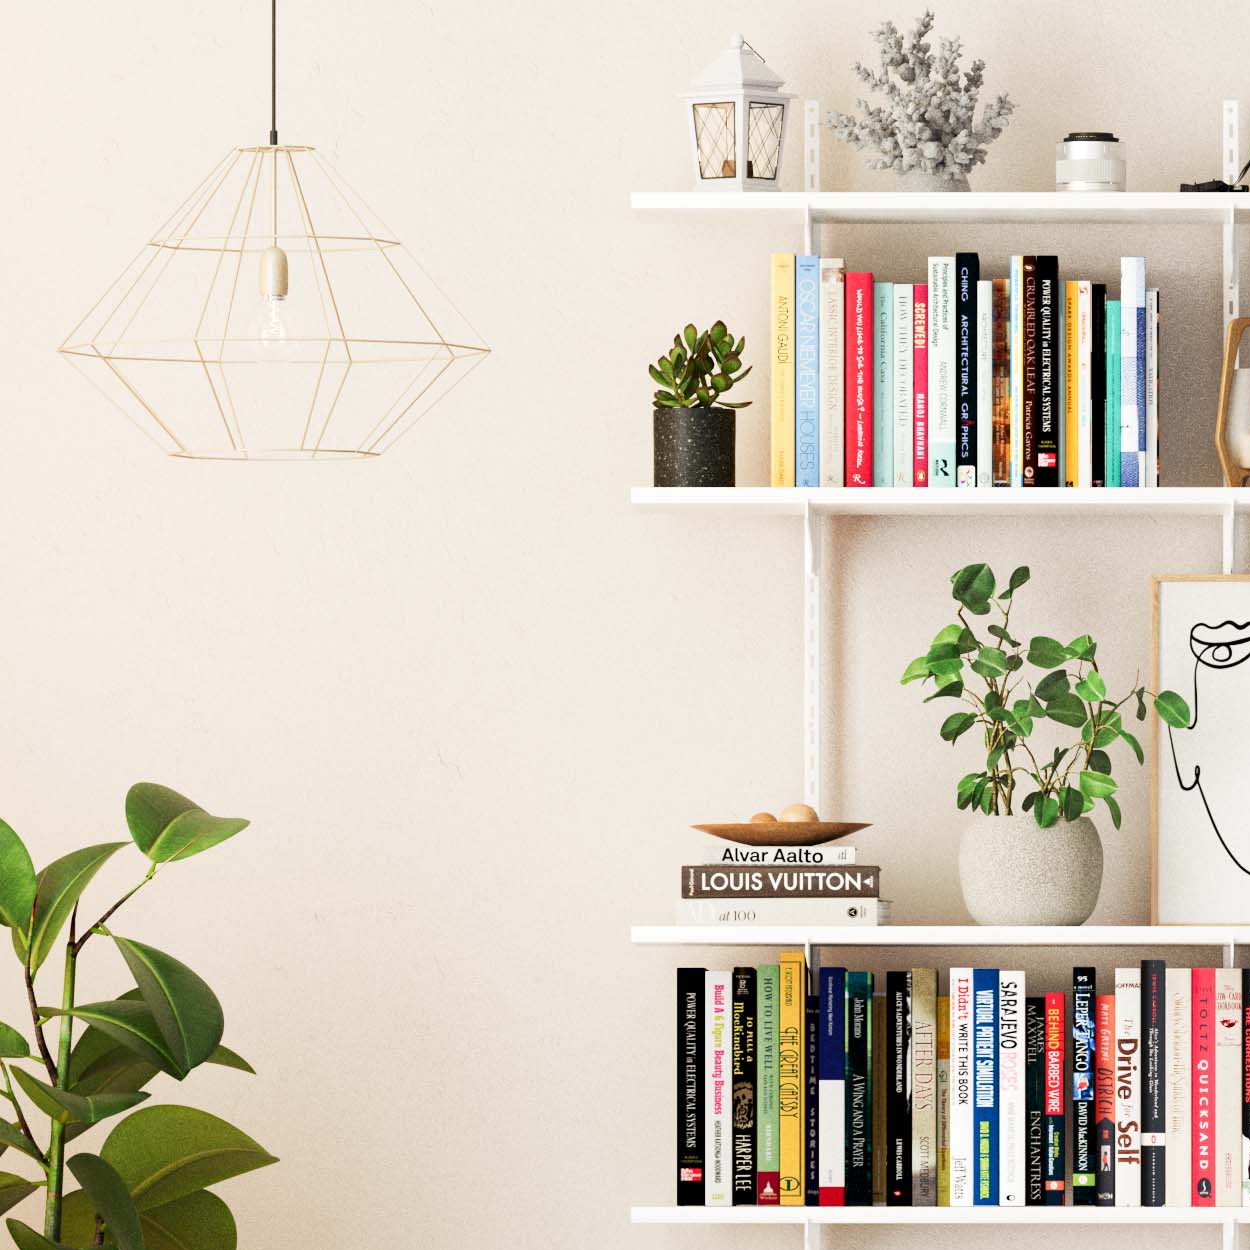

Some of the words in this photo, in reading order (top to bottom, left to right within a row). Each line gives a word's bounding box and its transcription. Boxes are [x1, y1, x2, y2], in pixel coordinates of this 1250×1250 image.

[961, 267, 969, 302] CHING
[1041, 280, 1050, 305] POWER
[801, 279, 815, 333] OSCAR
[1026, 277, 1036, 336] CRUMBLED
[915, 302, 925, 349] SCREWED!
[1041, 307, 1050, 340] QUALITY
[961, 315, 969, 396] ARCHITECTURAL
[1026, 339, 1036, 364] OAK
[801, 335, 816, 409] NIEMEYER
[1026, 367, 1036, 394] LEAF
[1041, 349, 1050, 395] ELECTRICAL
[1025, 400, 1033, 429] Patricia
[1041, 397, 1050, 432] SYSTEMS
[801, 412, 815, 470] HOUSES
[1025, 432, 1033, 460] Gavros
[722, 848, 768, 862] Alvar
[774, 848, 824, 863] Aalto
[702, 873, 762, 890] LOUIS
[768, 873, 862, 890] VUITTON
[686, 992, 696, 1019] POWER
[714, 984, 724, 1005] Build
[764, 978, 772, 1002] HOW
[854, 998, 863, 1013] John
[959, 986, 969, 1019] Didn't
[764, 1005, 772, 1017] TO
[976, 990, 993, 1024] VIRTUAL
[1000, 982, 1017, 1049] SARAJEVO
[1075, 993, 1090, 1032] LEPER
[685, 1021, 696, 1056] QUALITY
[713, 1023, 724, 1048] Figure
[732, 1002, 744, 1075] Mockingbird
[764, 1021, 772, 1042] LIVE
[780, 1027, 798, 1045] THE
[914, 1021, 933, 1069] AFTER
[958, 1023, 968, 1052] WRITE
[976, 1026, 993, 1058] PATIENT
[1027, 1005, 1036, 1064] MAXWELL
[1048, 1009, 1059, 1049] BEHIND
[712, 1050, 724, 1078] Beauty
[764, 1045, 772, 1070] WELL
[780, 1050, 798, 1079] GREAT
[958, 1056, 968, 1076] THIS
[1076, 1032, 1090, 1071] TANGO
[976, 1060, 993, 1107] SIMULATION
[1001, 1053, 1017, 1091] ROSES
[1048, 1051, 1059, 1088] BARBED
[1117, 1039, 1138, 1099] Drive
[686, 1065, 696, 1111] ELECTRICAL
[714, 1081, 724, 1114] Business
[780, 1083, 798, 1119] GATSBY
[852, 1083, 864, 1108] WING
[914, 1074, 933, 1111] DAYS
[958, 1079, 968, 1105] BOOK
[1048, 1089, 1059, 1112] WIRE
[853, 1110, 863, 1128] AND
[1078, 1102, 1087, 1125] DAVID
[1122, 1105, 1134, 1119] for
[1199, 1059, 1209, 1170] QUICKSAND
[686, 1114, 696, 1148] SYSTEMS
[1118, 1121, 1139, 1165] Self
[735, 1134, 751, 1172] HARPER
[852, 1137, 864, 1167] PRAYER
[952, 1157, 966, 1173] Jeff
[1030, 1111, 1041, 1200] ENCHANTRESS
[1078, 1126, 1087, 1171] MacKINNON
[736, 1174, 752, 1191] LEE
[954, 1175, 966, 1200] Watts
